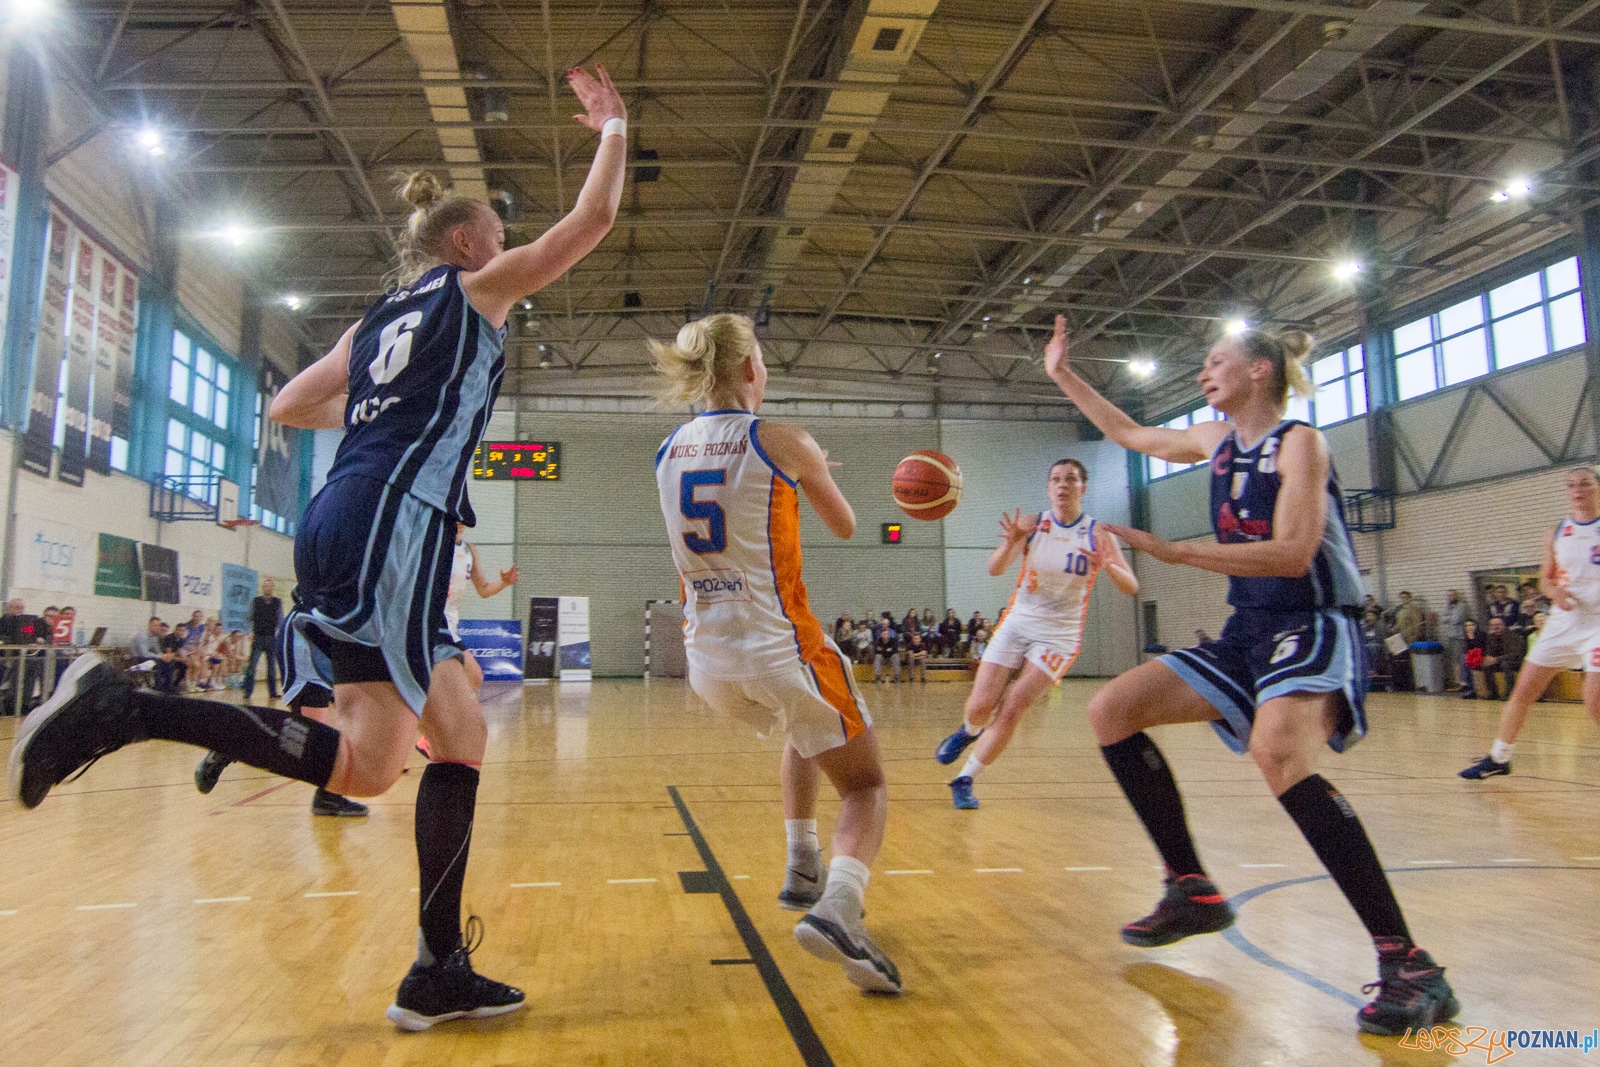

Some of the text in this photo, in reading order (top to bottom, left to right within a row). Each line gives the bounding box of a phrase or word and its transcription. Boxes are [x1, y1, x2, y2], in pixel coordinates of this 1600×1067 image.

[369, 310, 423, 386] 6
[669, 434, 749, 460] MUKS POZNAŃ
[680, 468, 728, 556] 5
[1064, 552, 1088, 576] 10
[53, 619, 72, 637] 5
